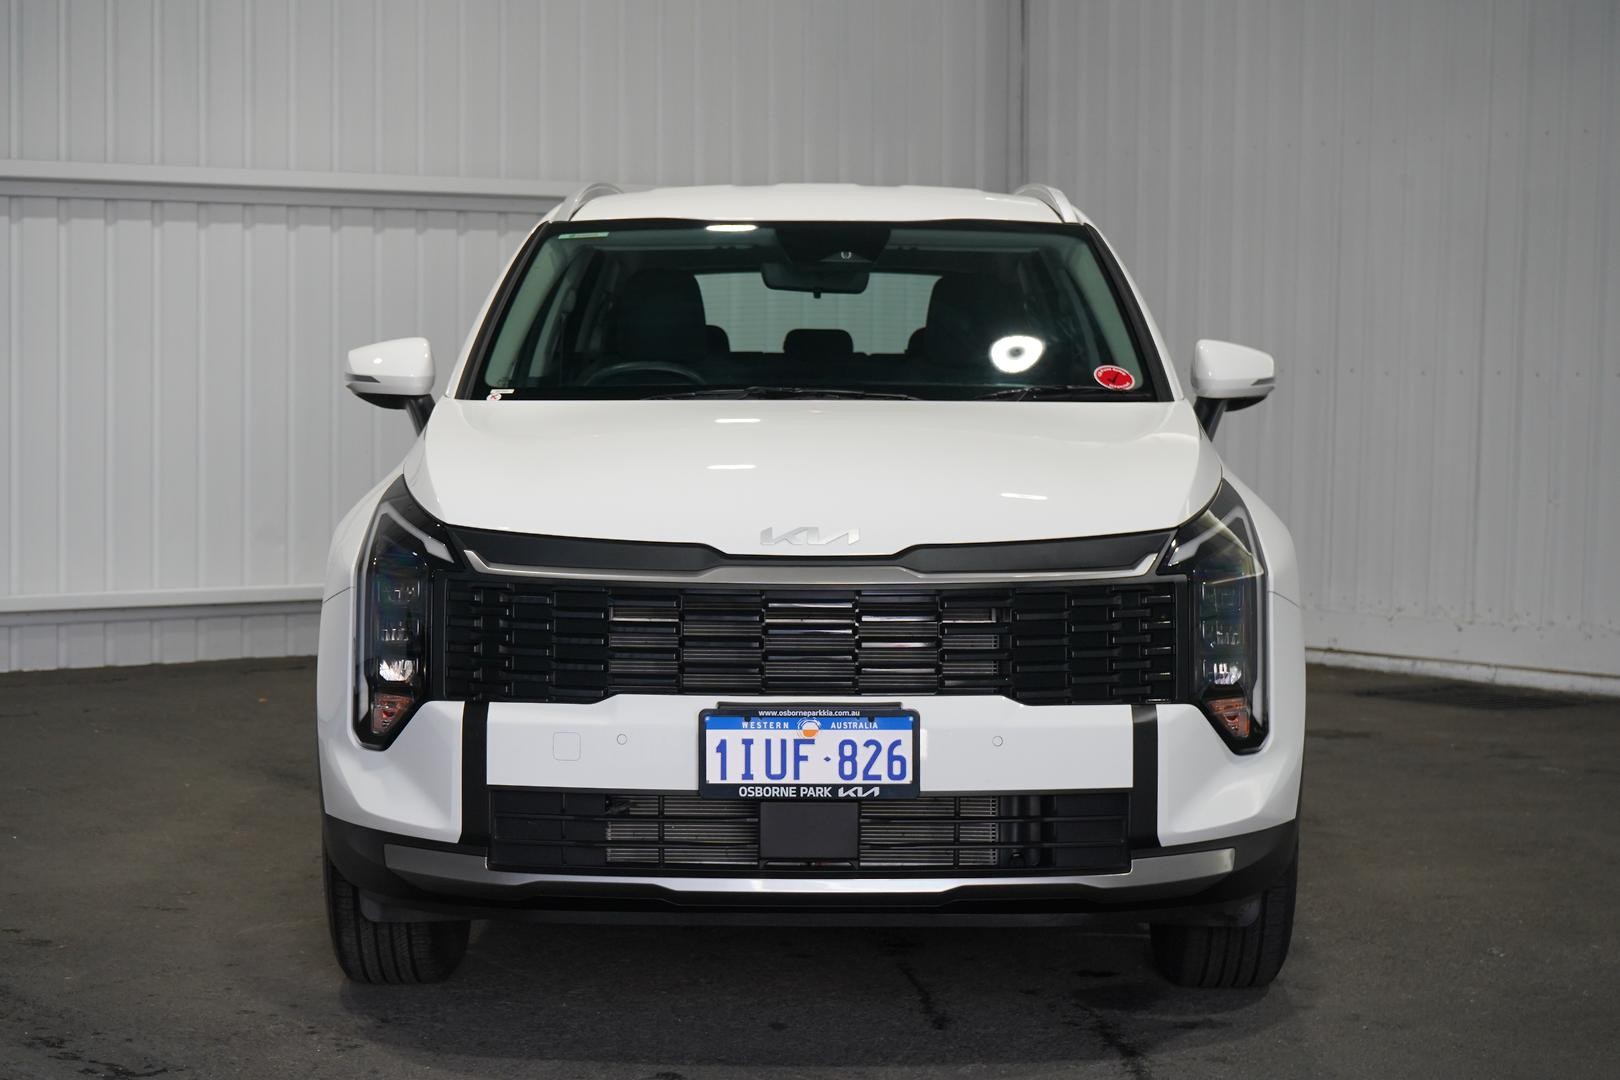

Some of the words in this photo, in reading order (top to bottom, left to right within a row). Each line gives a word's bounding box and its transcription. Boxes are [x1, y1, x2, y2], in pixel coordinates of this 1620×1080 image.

[758, 709, 860, 717] www.osborneparkkia.com.au
[741, 721, 789, 729] WESTERN
[830, 721, 878, 729] AUSTRALIA
[738, 786, 797, 797] OSBORNE
[800, 786, 832, 797] PARK
[837, 786, 880, 797] KIA
